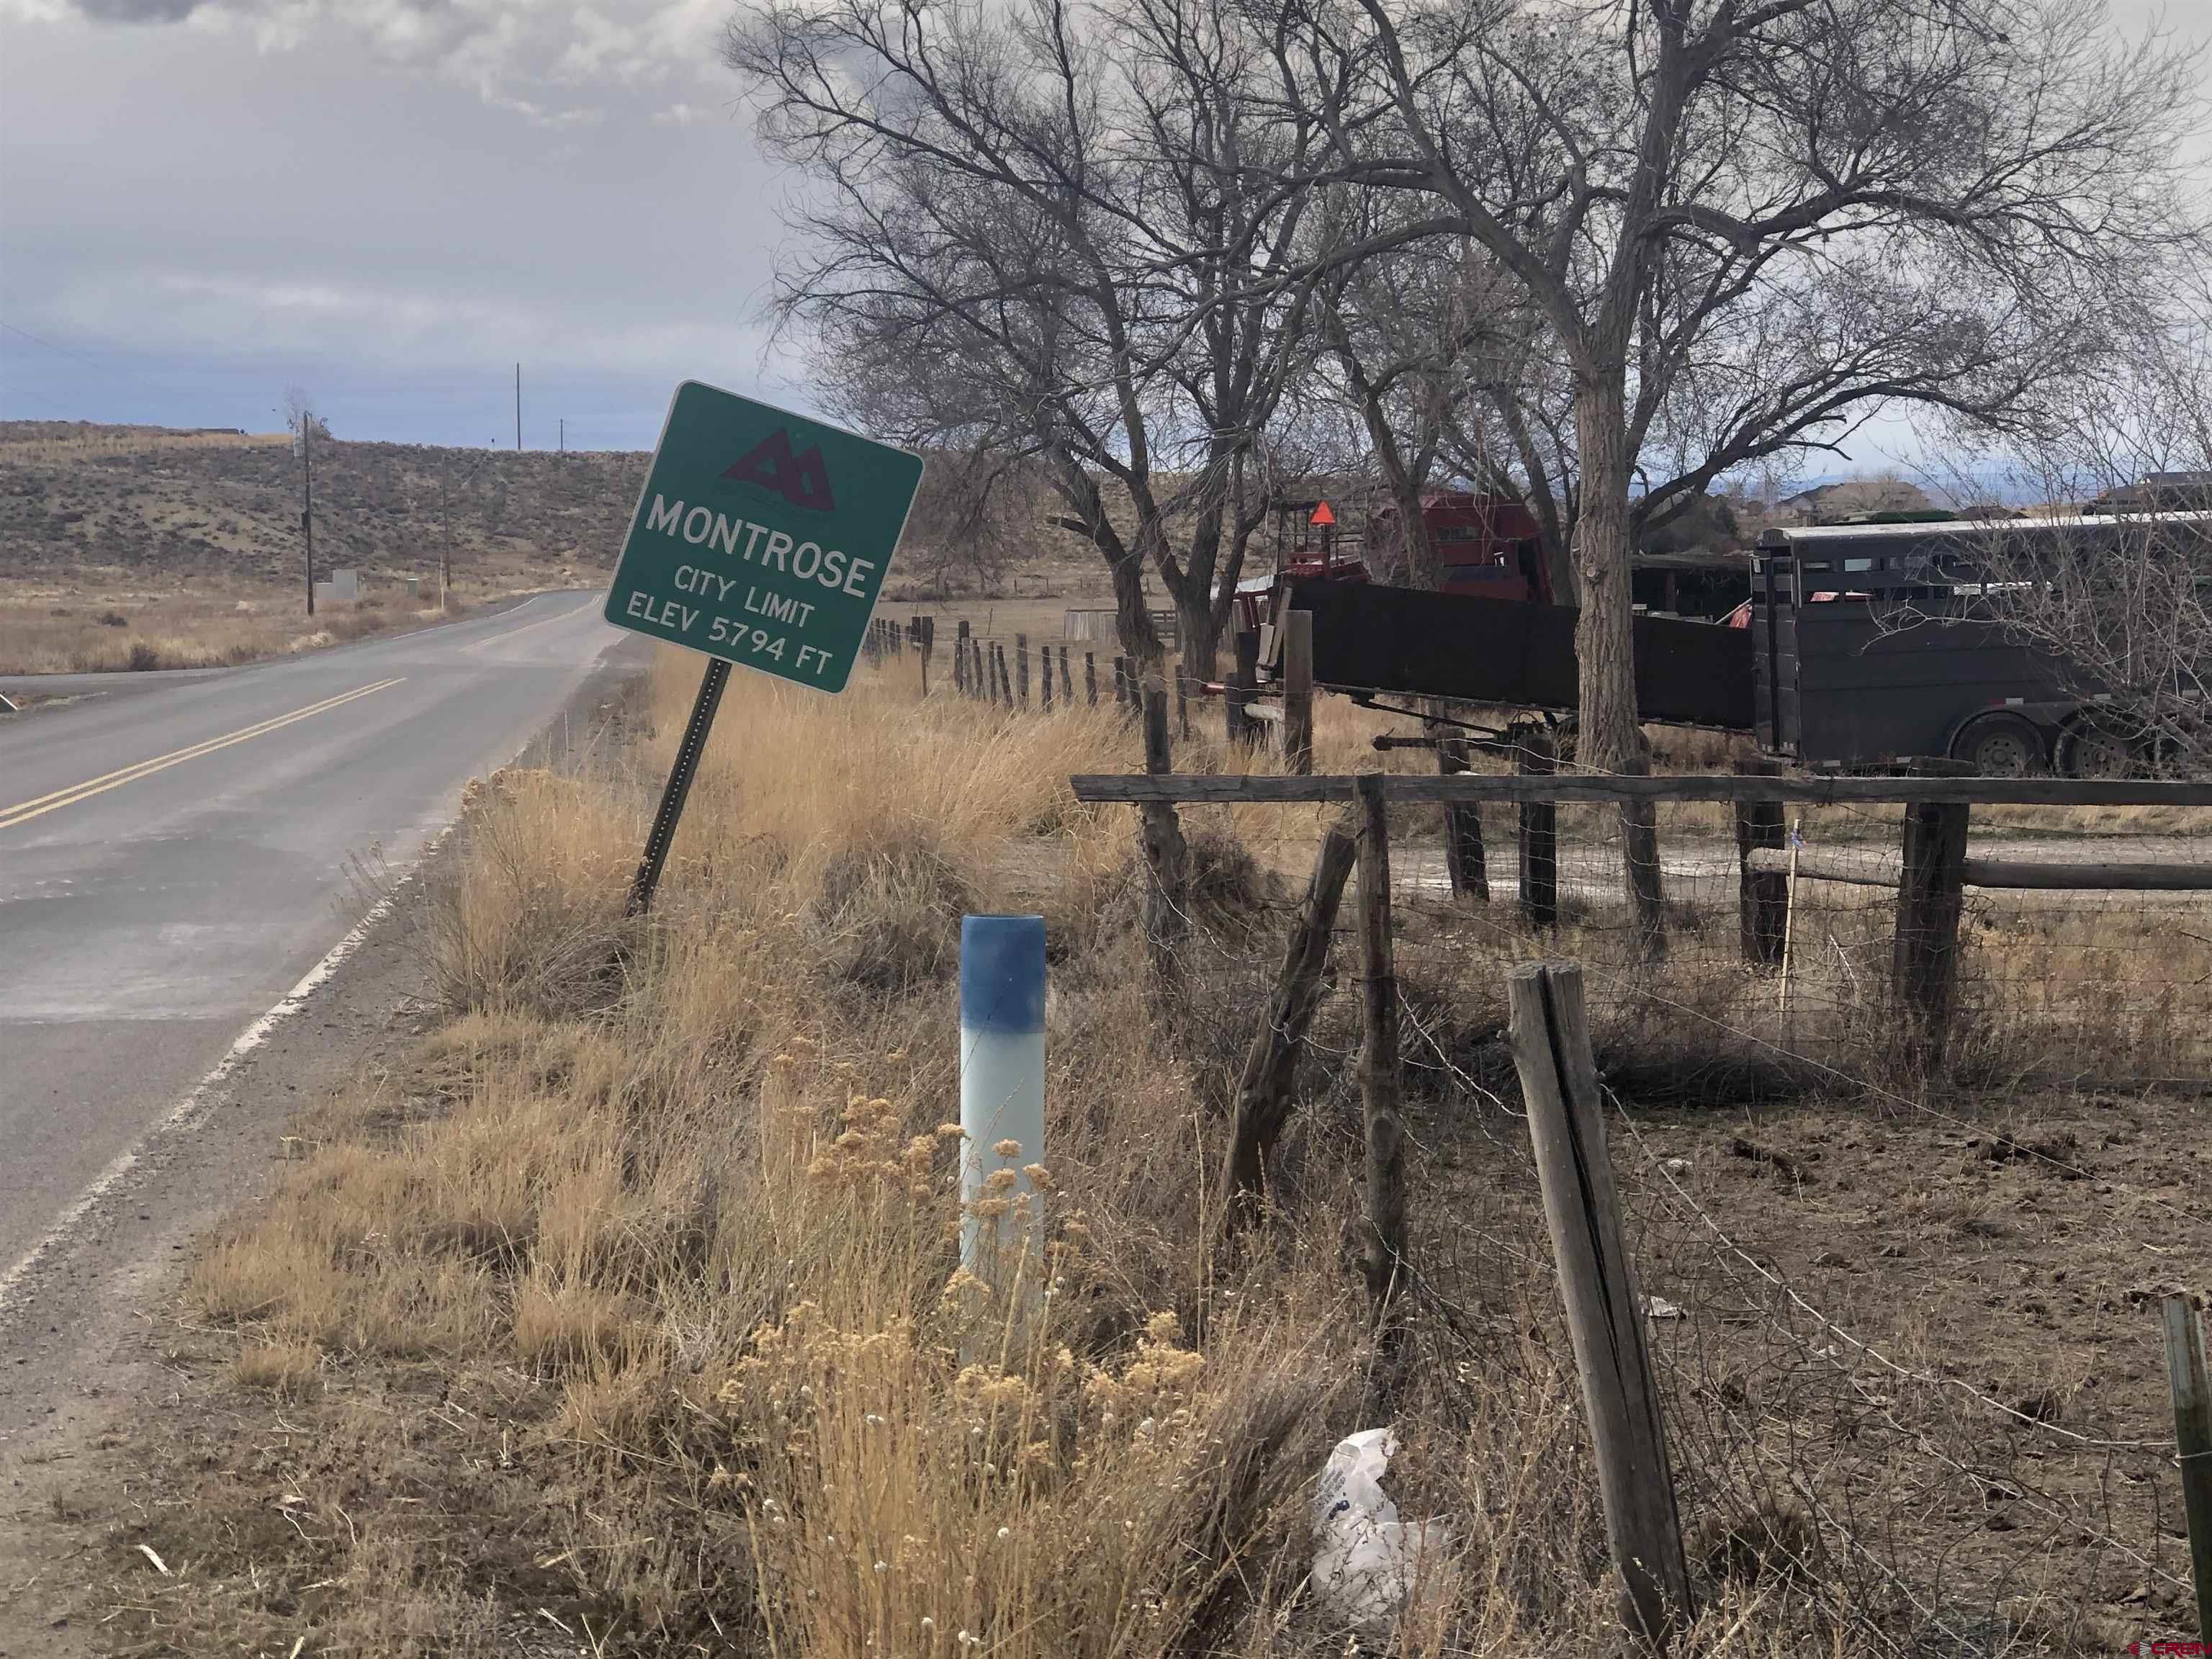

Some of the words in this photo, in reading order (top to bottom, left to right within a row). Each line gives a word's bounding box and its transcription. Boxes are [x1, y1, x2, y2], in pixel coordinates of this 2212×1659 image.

[646, 494, 874, 598] MONTROSE
[627, 591, 699, 631] ELEV
[709, 616, 786, 661] 5794
[796, 645, 832, 674] FT
[675, 565, 736, 601] CITY
[745, 587, 815, 627] LIMIT
